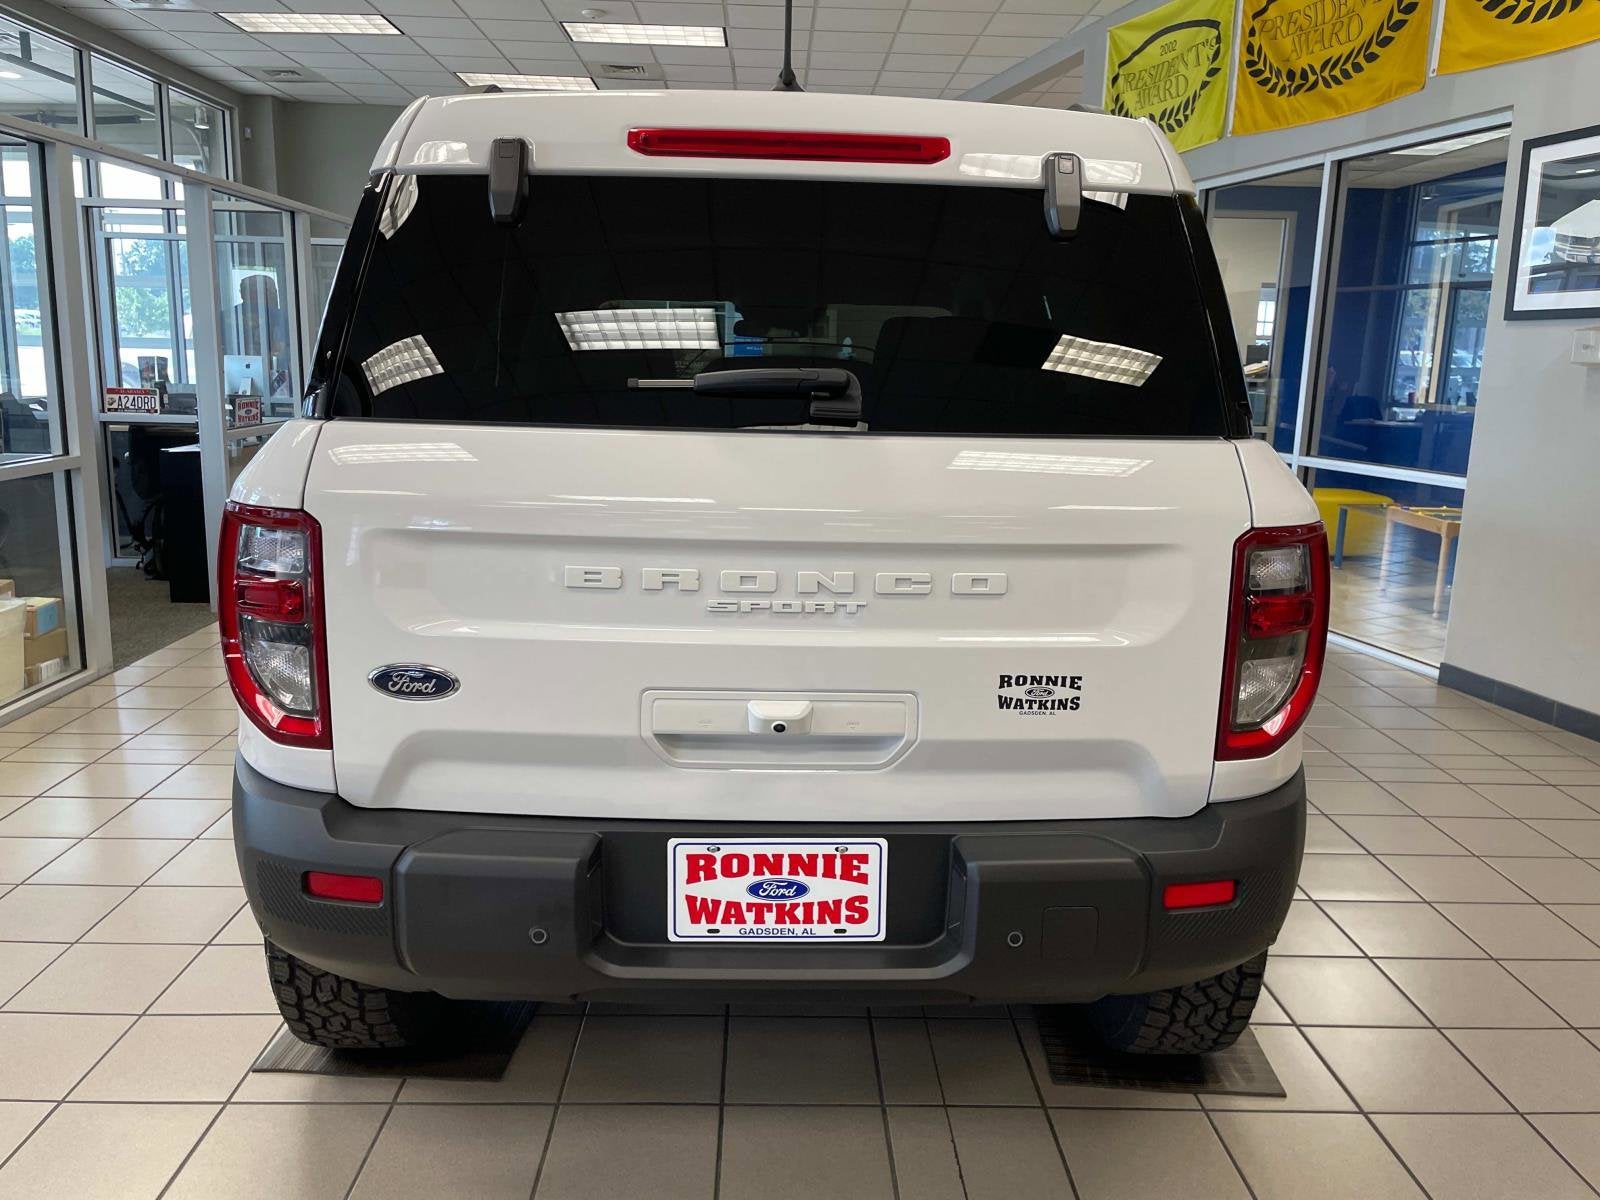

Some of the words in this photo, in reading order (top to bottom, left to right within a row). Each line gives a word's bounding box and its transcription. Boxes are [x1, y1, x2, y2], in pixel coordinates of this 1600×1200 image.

[1280, 12, 1364, 62] AWARD
[1160, 40, 1178, 57] 2002
[1133, 73, 1189, 112] AWARD
[564, 565, 1009, 596] BRONCO
[706, 599, 867, 614] SPORT
[998, 674, 1082, 691] RONNIE
[997, 694, 1081, 711] WATKINS
[685, 853, 870, 886] RONNIE
[758, 881, 799, 898] Ford
[684, 894, 870, 926] WATKINS
[738, 927, 799, 937] GADSDEN,
[800, 927, 817, 936] AL
